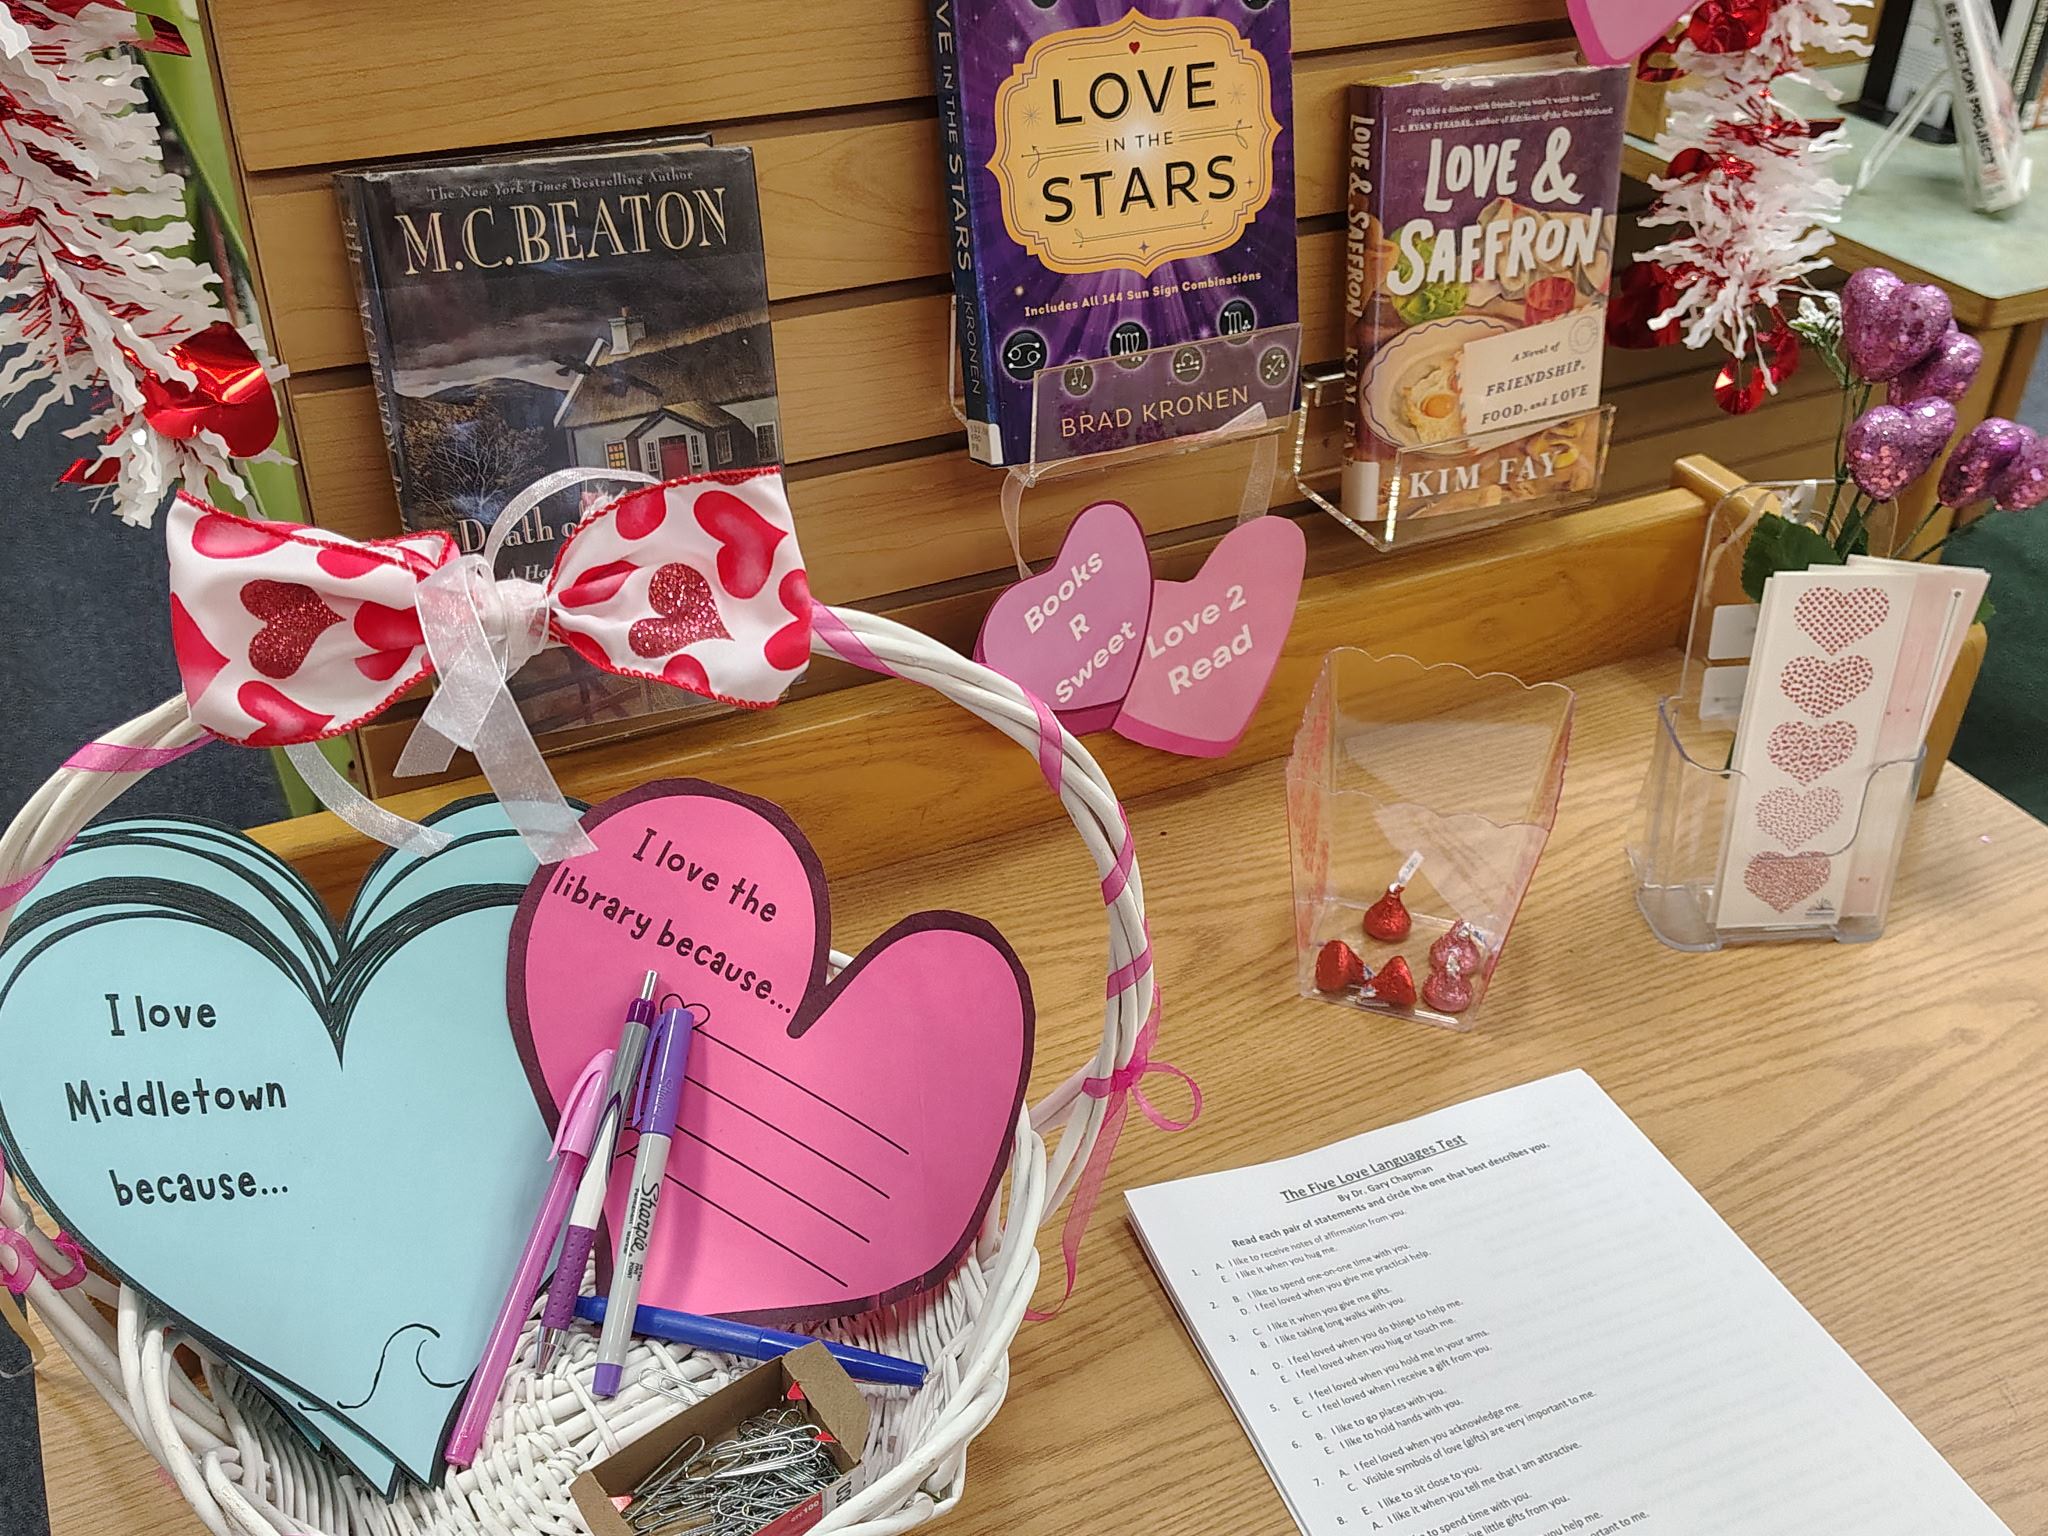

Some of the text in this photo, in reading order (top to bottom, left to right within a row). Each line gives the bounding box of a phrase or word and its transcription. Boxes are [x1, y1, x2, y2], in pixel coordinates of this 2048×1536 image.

[943, 65, 954, 90] IN
[1052, 62, 1218, 127] LOVE
[946, 95, 958, 144] THE
[1105, 131, 1174, 153] IN THE
[427, 167, 694, 201] The New York Times Bestselling Author
[1041, 155, 1237, 225] STARS
[1424, 127, 1585, 212] LOVE &
[949, 153, 972, 272] STARS
[1346, 114, 1376, 319] LOVE & SAFFRON
[1386, 207, 1603, 296] SAFFRON
[1024, 270, 1262, 318] Includes All 144 Sun Sign Combinations
[964, 301, 981, 395] KRONEN
[1511, 341, 1561, 362] A Novel of
[1061, 386, 1250, 438] BRAD KRONEN
[1529, 397, 1548, 411] and
[1550, 384, 1590, 406] LOVE
[1408, 450, 1563, 500] KIM FAY
[457, 506, 555, 553] Dath
[1023, 552, 1104, 635] Books
[1145, 584, 1247, 660] Love 2
[1068, 613, 1092, 643] R
[1054, 621, 1137, 704] Sweet
[1167, 624, 1254, 696] Read
[631, 827, 778, 923] I love the
[552, 866, 793, 1016] library because...
[104, 993, 217, 1036] I love
[64, 1078, 288, 1123] Middletown
[109, 1169, 288, 1206] because...
[1231, 1234, 1258, 1248] Read
[1258, 1229, 1281, 1241] each
[1282, 1223, 1301, 1236] pair
[1302, 1219, 1313, 1228] of
[1313, 1204, 1367, 1225] statements
[1366, 1196, 1386, 1208] and
[1386, 1189, 1411, 1202] circle
[1410, 1183, 1428, 1193] the
[1428, 1177, 1447, 1187] one
[1446, 1169, 1467, 1181] that
[1465, 1162, 1488, 1175] best
[1487, 1148, 1529, 1167] describes
[1279, 1135, 1466, 1203] The Five Love Languages Test
[1336, 1193, 1351, 1202] By
[1366, 1180, 1390, 1192] Gary
[1389, 1166, 1433, 1184] Chapman
[630, 1173, 660, 1253] Sharpie
[1232, 1257, 1249, 1266] like
[1248, 1254, 1259, 1262] to
[1260, 1246, 1290, 1259] receive
[1290, 1239, 1314, 1250] notes
[1313, 1234, 1323, 1243] of
[1323, 1222, 1368, 1240] affirmation
[1367, 1215, 1389, 1225] from
[1239, 1269, 1257, 1278] like
[1255, 1266, 1264, 1274] it
[1264, 1260, 1289, 1272] when
[1288, 1255, 1305, 1266] you
[1303, 1250, 1322, 1260] hug
[1313, 1385, 1333, 1398] feel
[1331, 1376, 1358, 1392] loved
[1357, 1369, 1383, 1382] when
[1382, 1363, 1400, 1375] you
[1398, 1353, 1420, 1367] hold
[1419, 1350, 1435, 1359] me
[1443, 1338, 1464, 1351] your
[1321, 1398, 1341, 1411] feel
[1340, 1389, 1367, 1405] loved
[1366, 1382, 1392, 1395] when
[1396, 1368, 1428, 1384] receive
[1435, 1359, 1451, 1372] gift
[1449, 1351, 1472, 1364] from
[1358, 1455, 1378, 1470] feel
[1377, 1446, 1405, 1463] loved
[1404, 1438, 1431, 1452] when
[1429, 1431, 1448, 1444] you
[1447, 1408, 1505, 1435] acknowledge
[1361, 1469, 1395, 1485] Visible
[1395, 1454, 1432, 1474] symbols
[1432, 1448, 1443, 1459] of
[1441, 1443, 1463, 1455] love
[1462, 1430, 1489, 1448] (gifts)
[1489, 1426, 1505, 1436] are
[1504, 1417, 1525, 1429] very
[1523, 1400, 1569, 1421] important
[1567, 1396, 1579, 1405] to
[803, 1500, 820, 1514] 100
